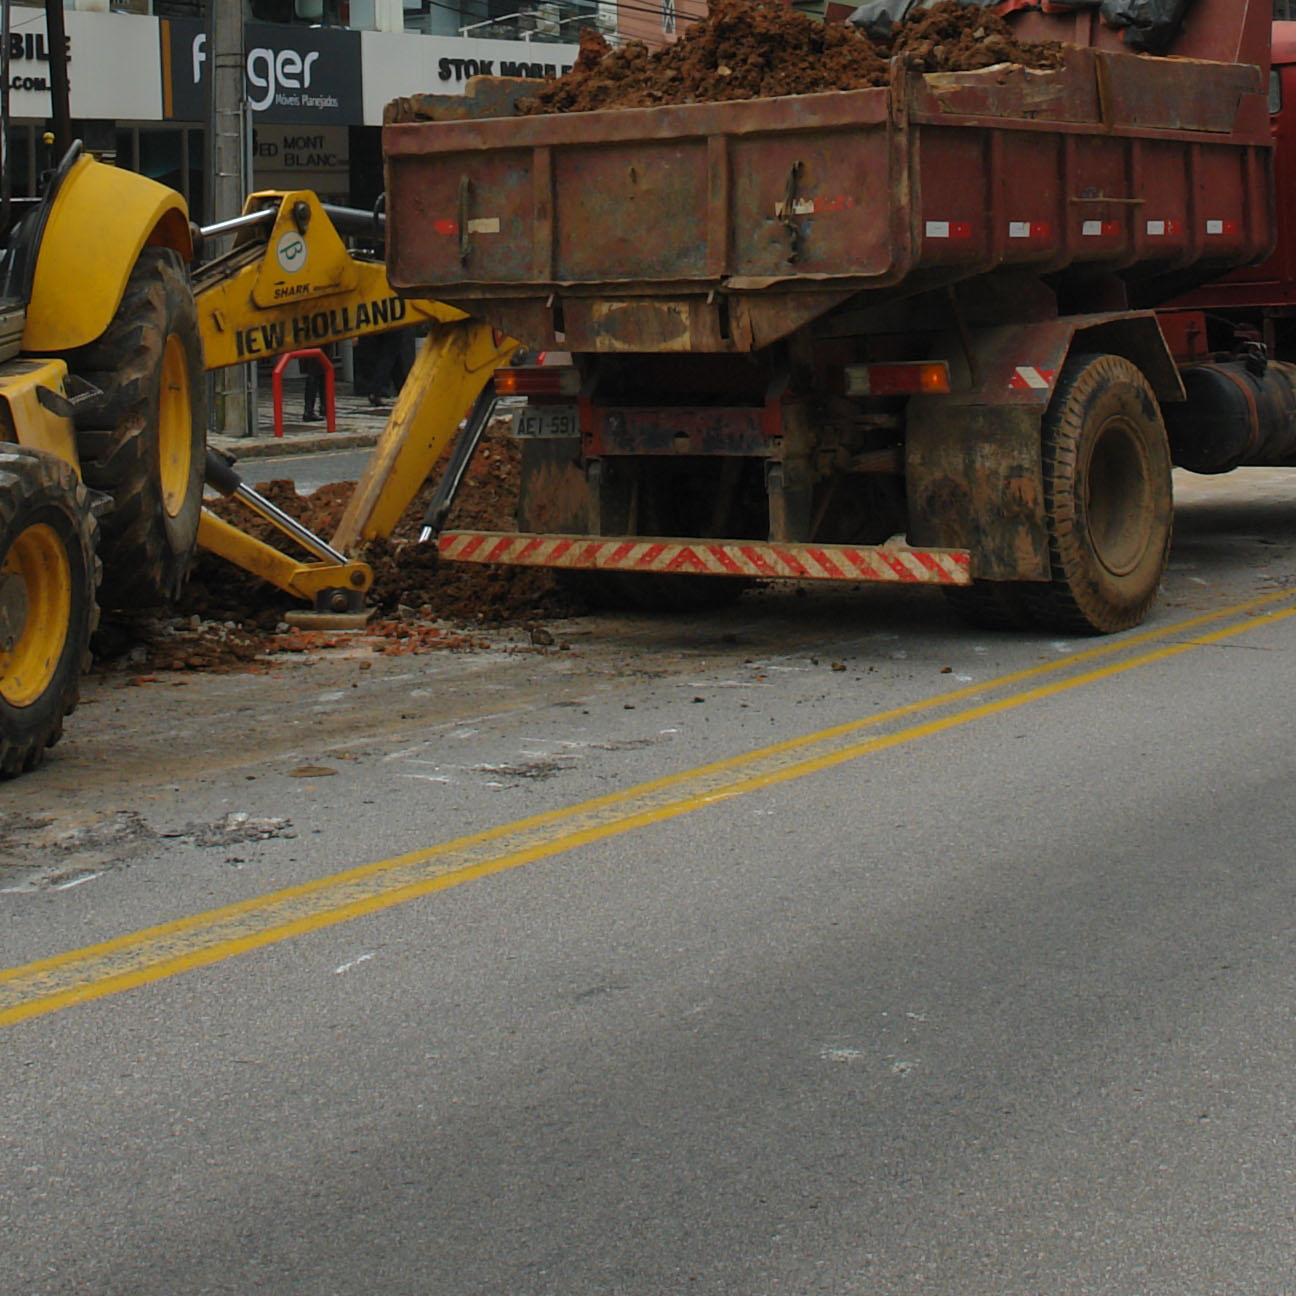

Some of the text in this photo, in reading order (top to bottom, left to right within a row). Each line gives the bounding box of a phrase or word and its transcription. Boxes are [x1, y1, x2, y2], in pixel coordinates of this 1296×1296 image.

[191, 33, 320, 112] fger
[437, 57, 495, 82] STOK
[284, 135, 325, 150] MONT
[284, 152, 337, 167] BLANC
[272, 283, 311, 299] SHARK
[291, 295, 407, 346] HOLLAND
